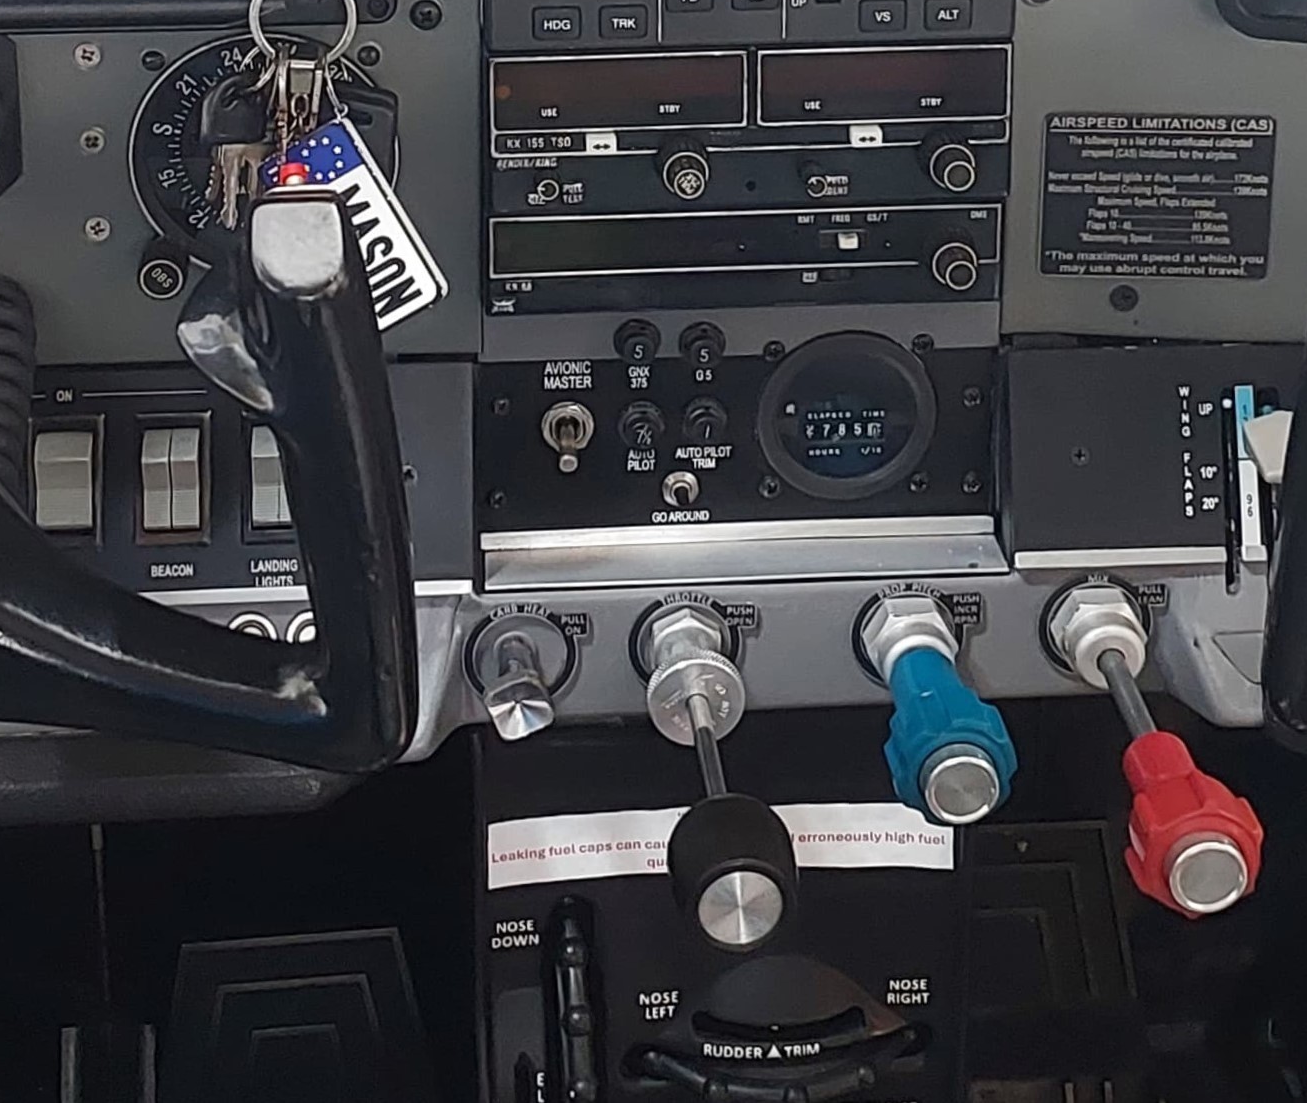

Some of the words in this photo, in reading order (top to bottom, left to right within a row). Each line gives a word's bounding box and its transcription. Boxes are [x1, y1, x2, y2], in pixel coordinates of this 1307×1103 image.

[875, 12, 891, 22] VS
[938, 10, 959, 20] ALT
[544, 20, 571, 30] HDG
[612, 18, 636, 29] TRK
[222, 47, 242, 67] 24
[176, 74, 198, 95] 21
[804, 101, 820, 110] USE
[921, 98, 941, 107] STBY
[541, 108, 557, 117] USE
[659, 105, 680, 113] STBY
[152, 122, 173, 136] S
[1050, 117, 1128, 129] AIRSPEED
[1132, 117, 1226, 130] LIMITATIONS
[1230, 118, 1273, 133] (CAS)
[507, 139, 521, 148] KX
[527, 138, 544, 148] 155
[159, 169, 175, 189] 15
[188, 211, 211, 229] 12
[343, 183, 423, 320] MASON
[151, 267, 174, 289] OBS
[545, 362, 591, 374] AVIONIC
[629, 366, 650, 377] GNX
[544, 377, 592, 389] MASTER
[631, 378, 648, 388] 375
[56, 390, 73, 402] ON
[1178, 386, 1190, 438] WING
[1198, 403, 1213, 416] UP
[628, 449, 655, 459] AUTO
[675, 448, 702, 458] AUTO
[704, 446, 732, 457] PILOT
[628, 460, 655, 470] PILOT
[693, 458, 716, 468] TRIM
[1200, 465, 1218, 479] 10°
[1183, 453, 1195, 517] FLAPS
[1201, 496, 1219, 511] 20°
[652, 512, 667, 522] GO
[668, 510, 709, 521] AROUND
[151, 563, 193, 577] BEACON
[250, 559, 298, 573] LANDING
[255, 575, 294, 587] LIGHTS
[953, 595, 979, 603] PUSH
[726, 606, 753, 616] PUSH
[561, 615, 585, 625] PULL
[565, 625, 581, 635] ON
[798, 831, 882, 845] erroneously
[885, 831, 915, 846] high
[918, 833, 946, 846] fuel
[492, 846, 546, 863] Leaking
[549, 843, 576, 857] fuel
[578, 841, 613, 855] caps
[615, 839, 641, 850] can
[496, 919, 535, 934] NOSE
[491, 934, 540, 949] DOWN
[889, 978, 928, 991] NOSE
[639, 991, 679, 1006] NOSE
[887, 991, 930, 1005] RIGHT
[645, 1005, 675, 1020] LEFT
[703, 1043, 763, 1060] RUDDER
[784, 1043, 821, 1058] TRIM
